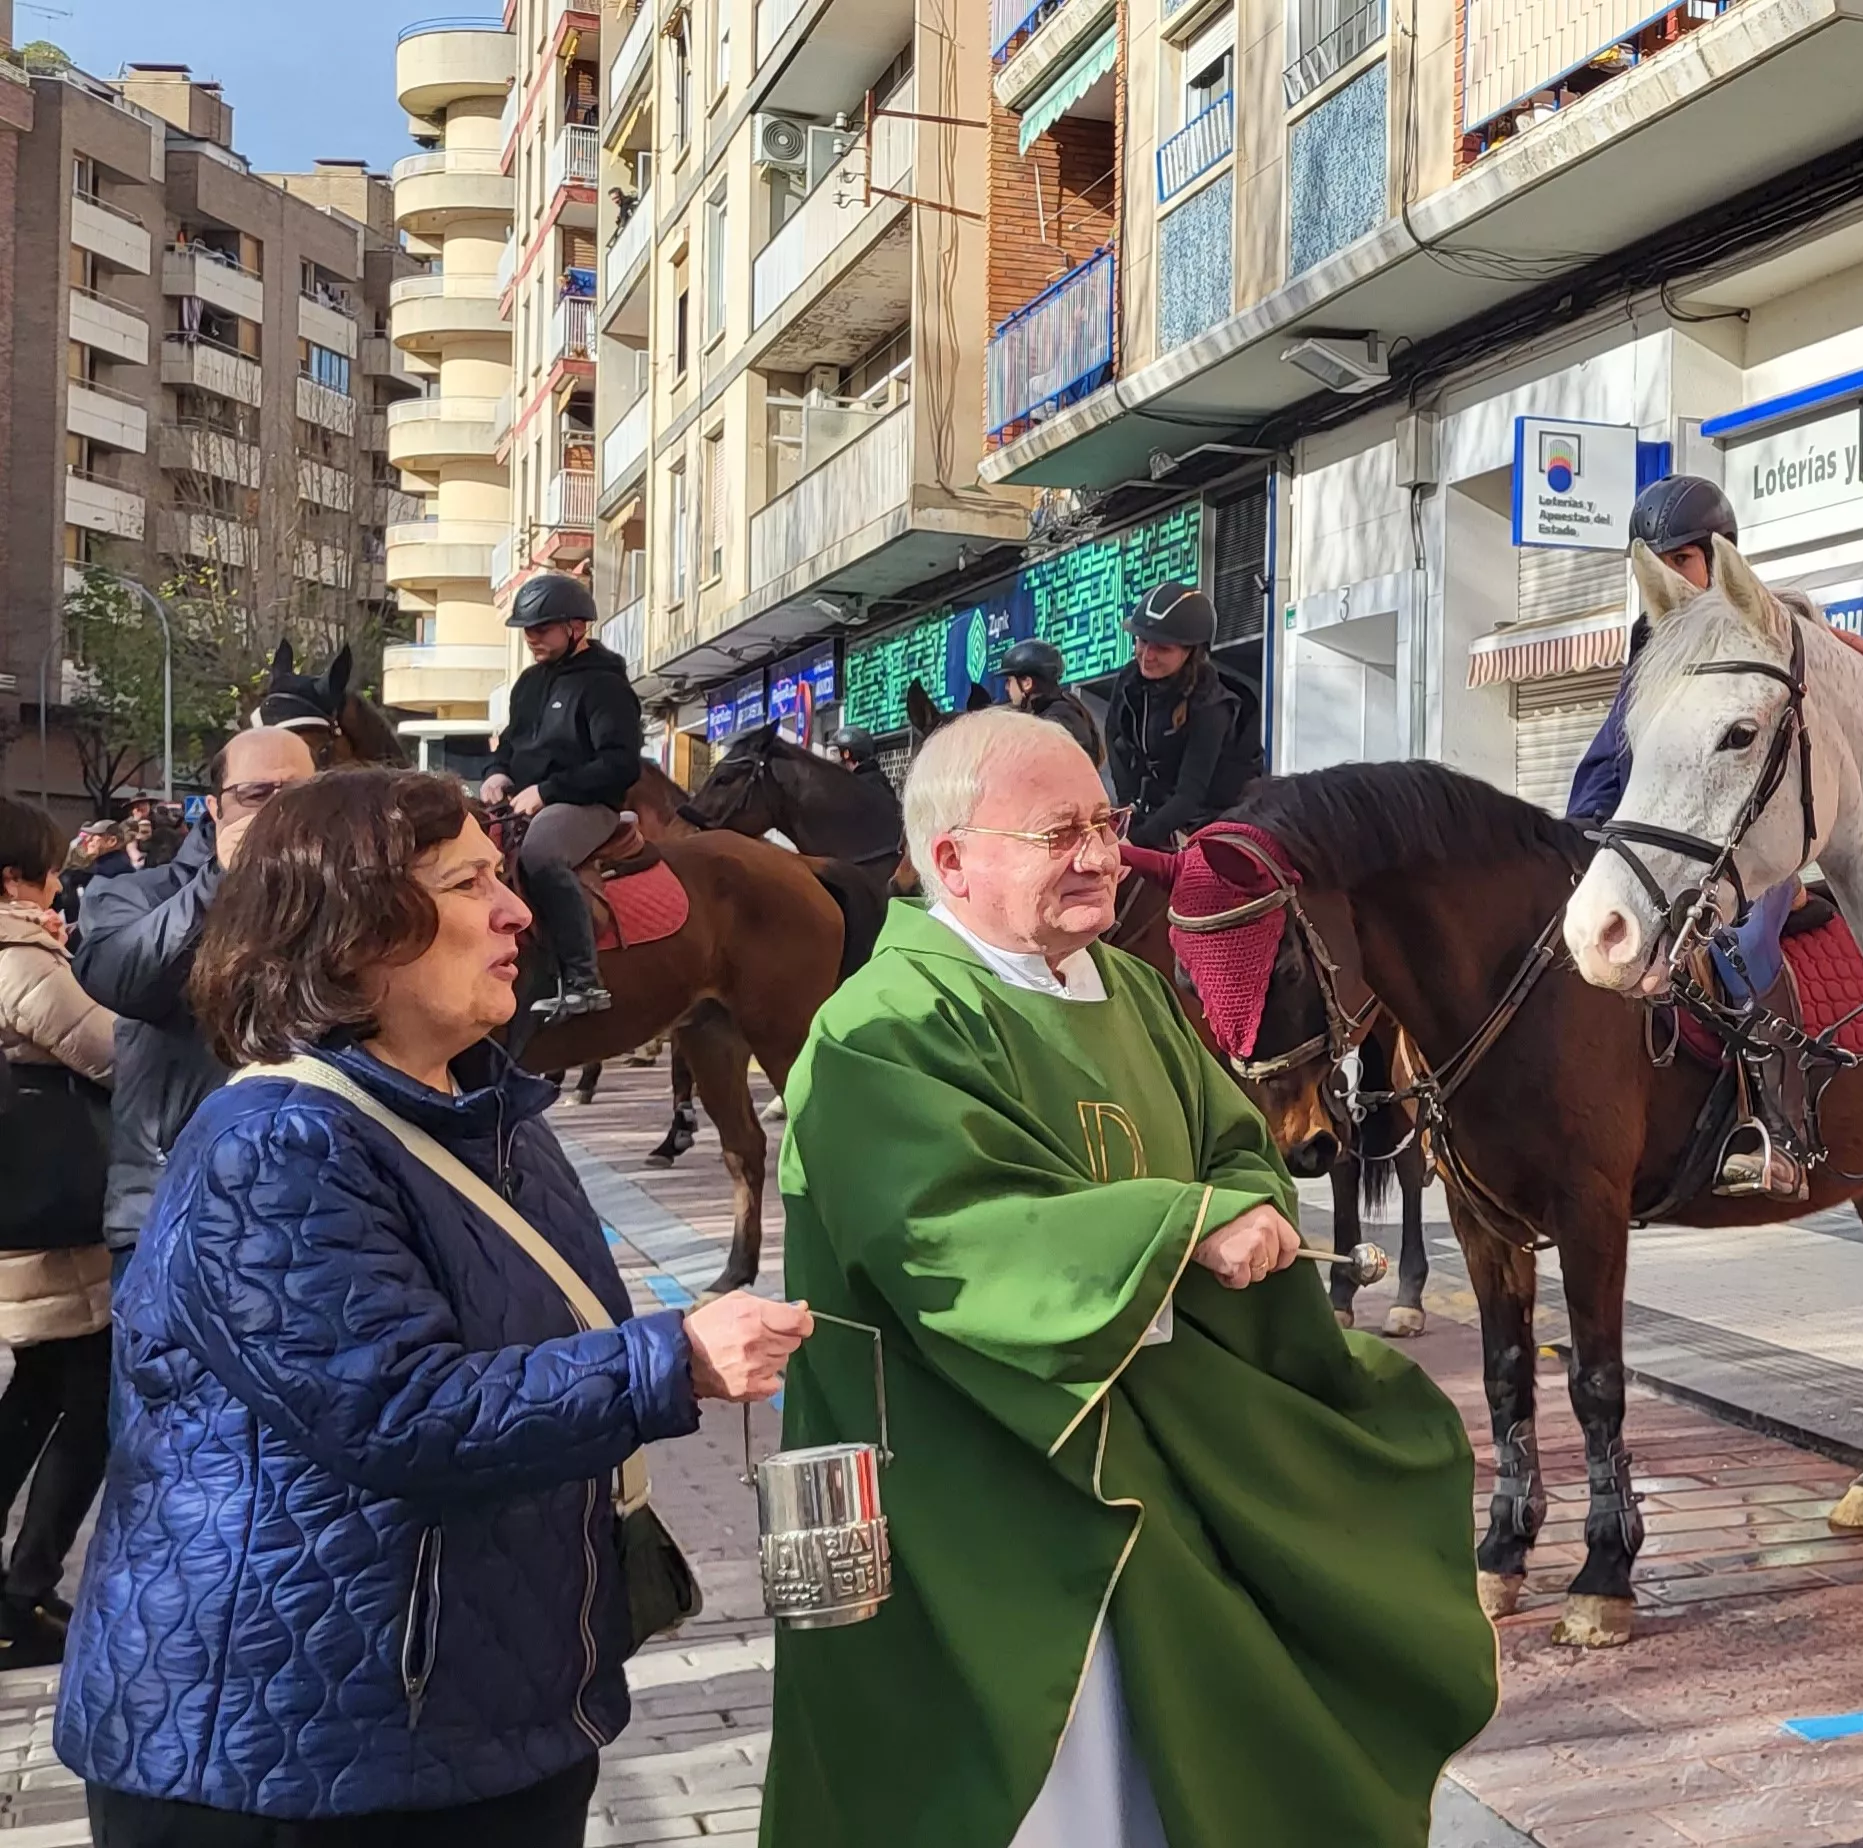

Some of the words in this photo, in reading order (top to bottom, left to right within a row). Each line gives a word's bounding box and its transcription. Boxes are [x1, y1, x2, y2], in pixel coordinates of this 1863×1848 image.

[1753, 446, 1837, 499] Loterías
[1845, 444, 1858, 485] y
[1538, 523, 1577, 536] Estado
[1340, 587, 1350, 621] 3
